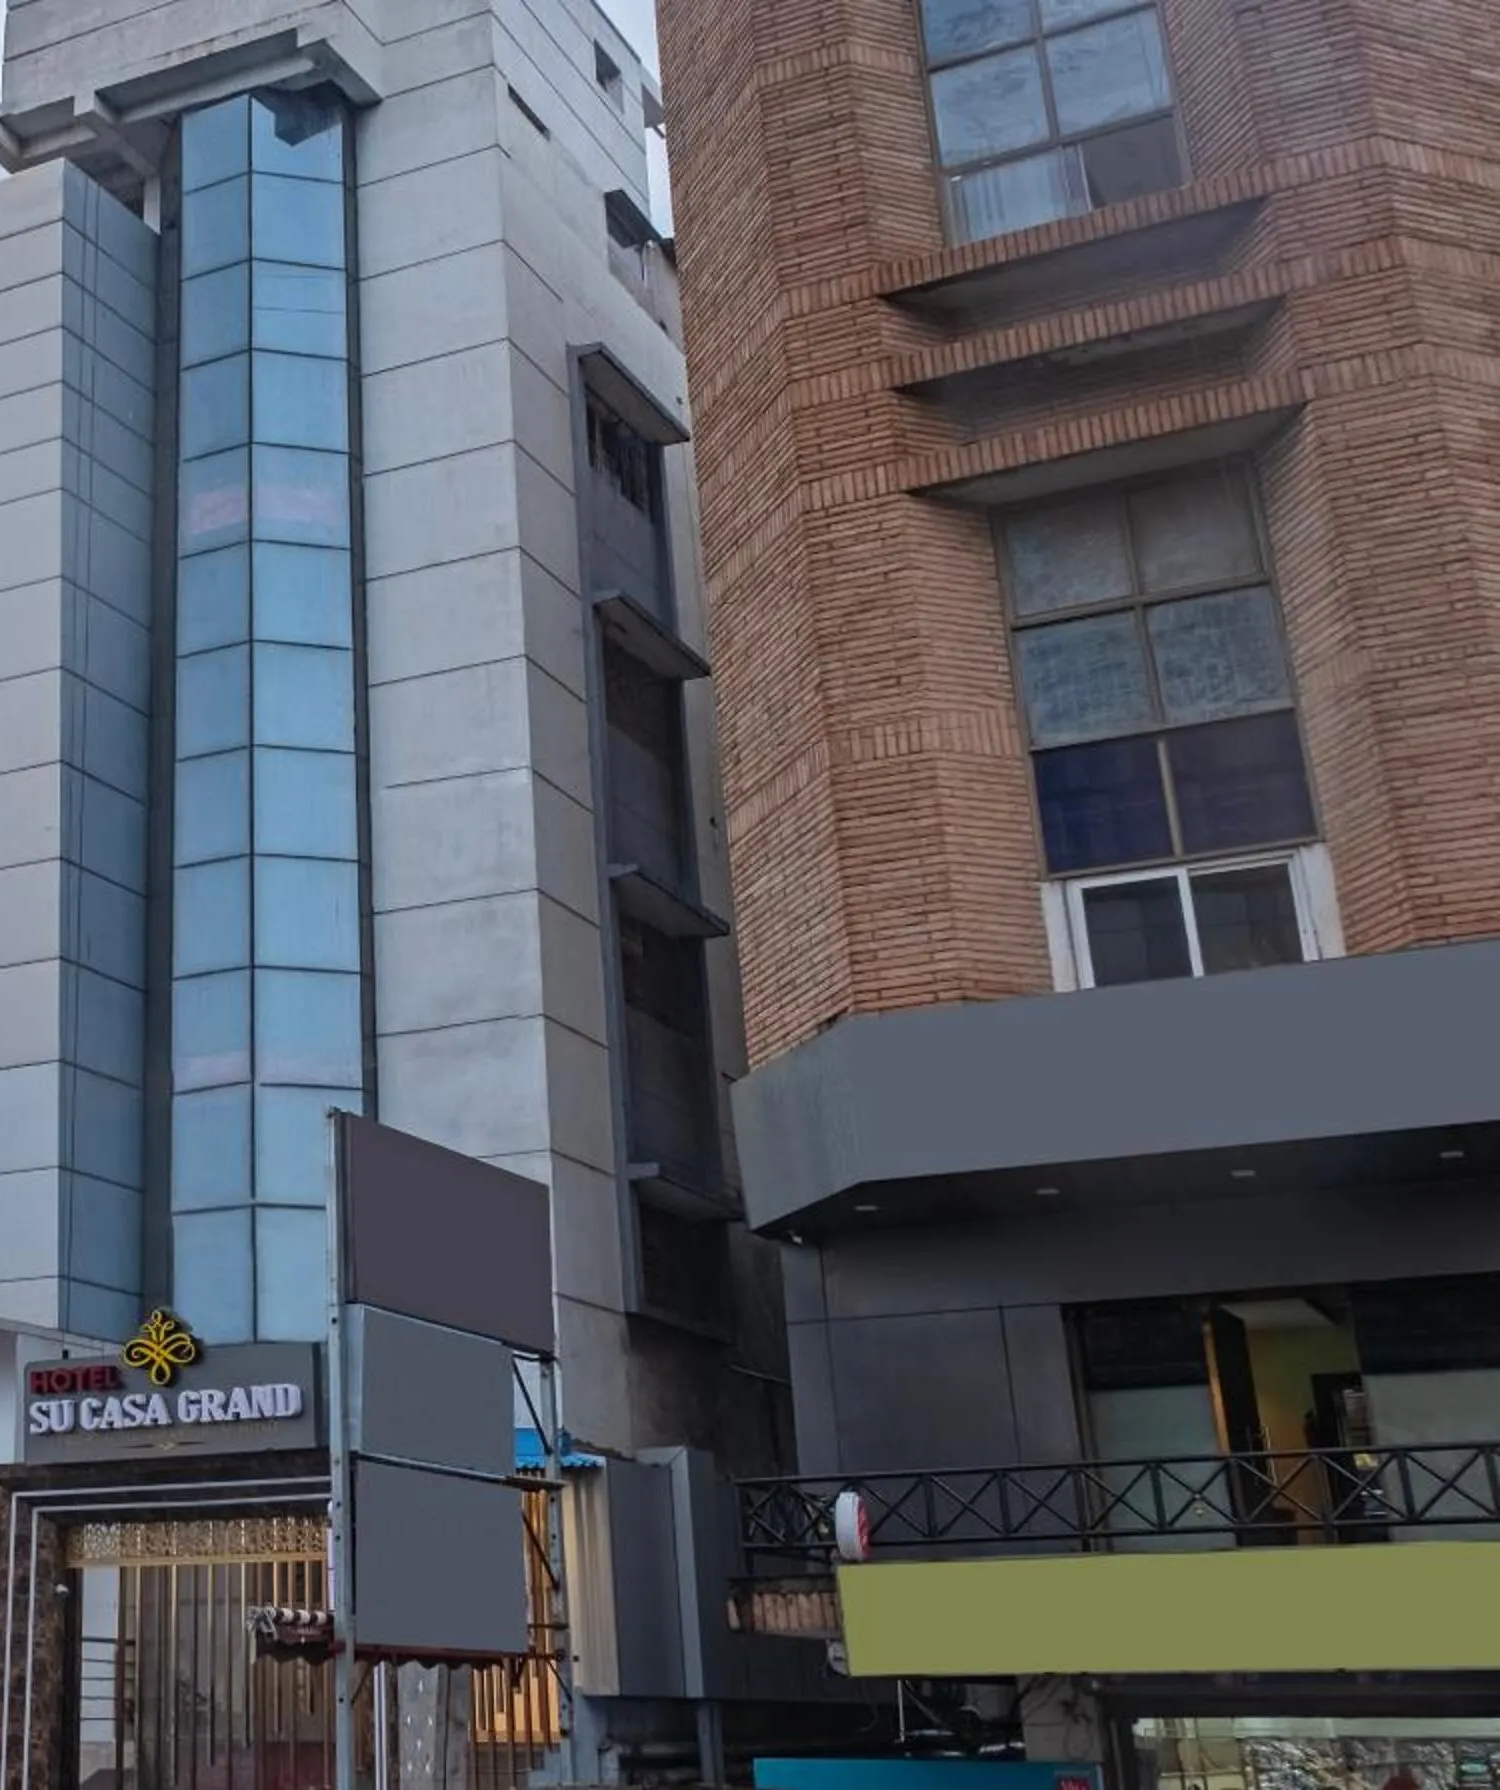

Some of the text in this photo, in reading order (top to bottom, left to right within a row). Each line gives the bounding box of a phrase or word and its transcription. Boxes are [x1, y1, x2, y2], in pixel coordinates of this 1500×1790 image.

[29, 1366, 119, 1394] HOTEL
[29, 1383, 302, 1434] SU CASA GRAND
